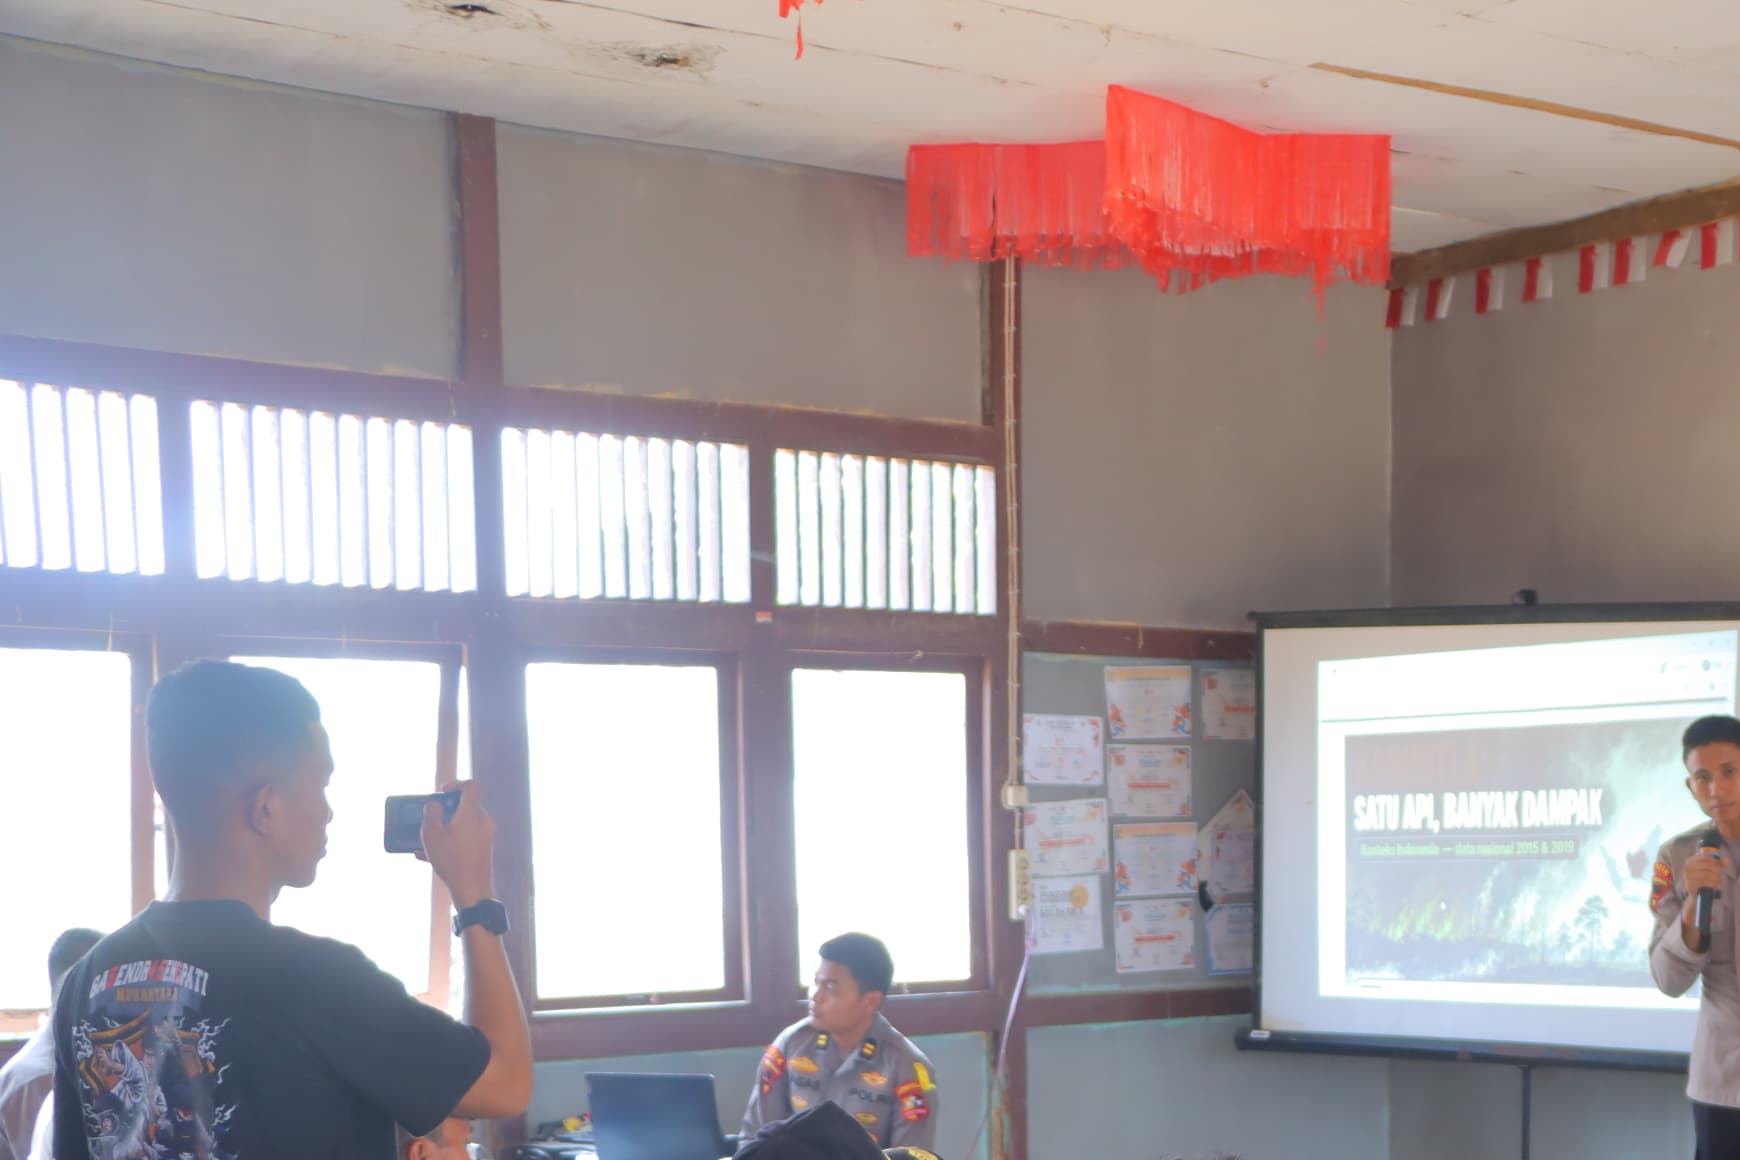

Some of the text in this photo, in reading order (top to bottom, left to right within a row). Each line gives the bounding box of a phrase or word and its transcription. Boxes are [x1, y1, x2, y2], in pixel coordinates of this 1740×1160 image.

[1353, 787, 1604, 834] SATU API, BANYAK DAMPAK
